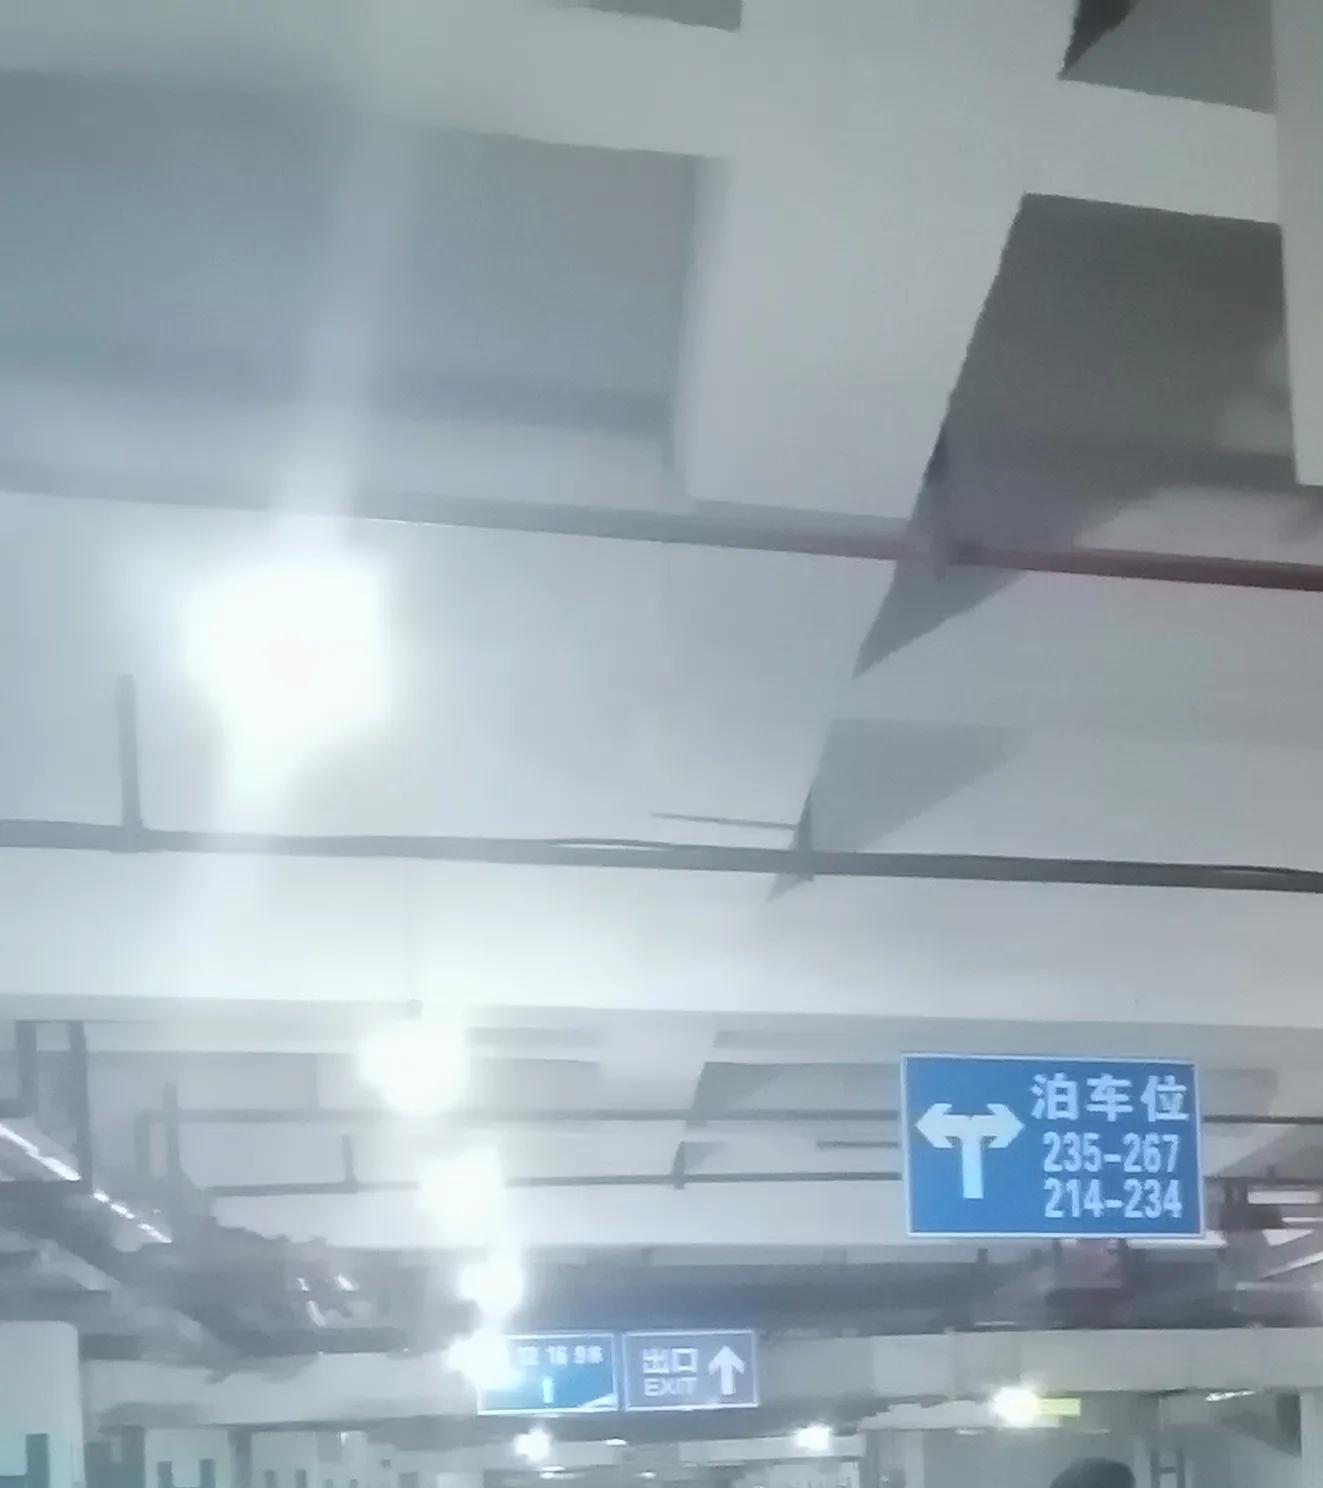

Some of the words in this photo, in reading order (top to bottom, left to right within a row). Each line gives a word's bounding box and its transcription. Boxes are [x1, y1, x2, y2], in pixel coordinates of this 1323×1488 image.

[1031, 1071, 1190, 1123] 泊车位
[1042, 1131, 1181, 1174] 235-267
[1043, 1177, 1183, 1219] 214-234
[642, 1348, 698, 1374] 出口
[644, 1376, 698, 1397] EXIT
